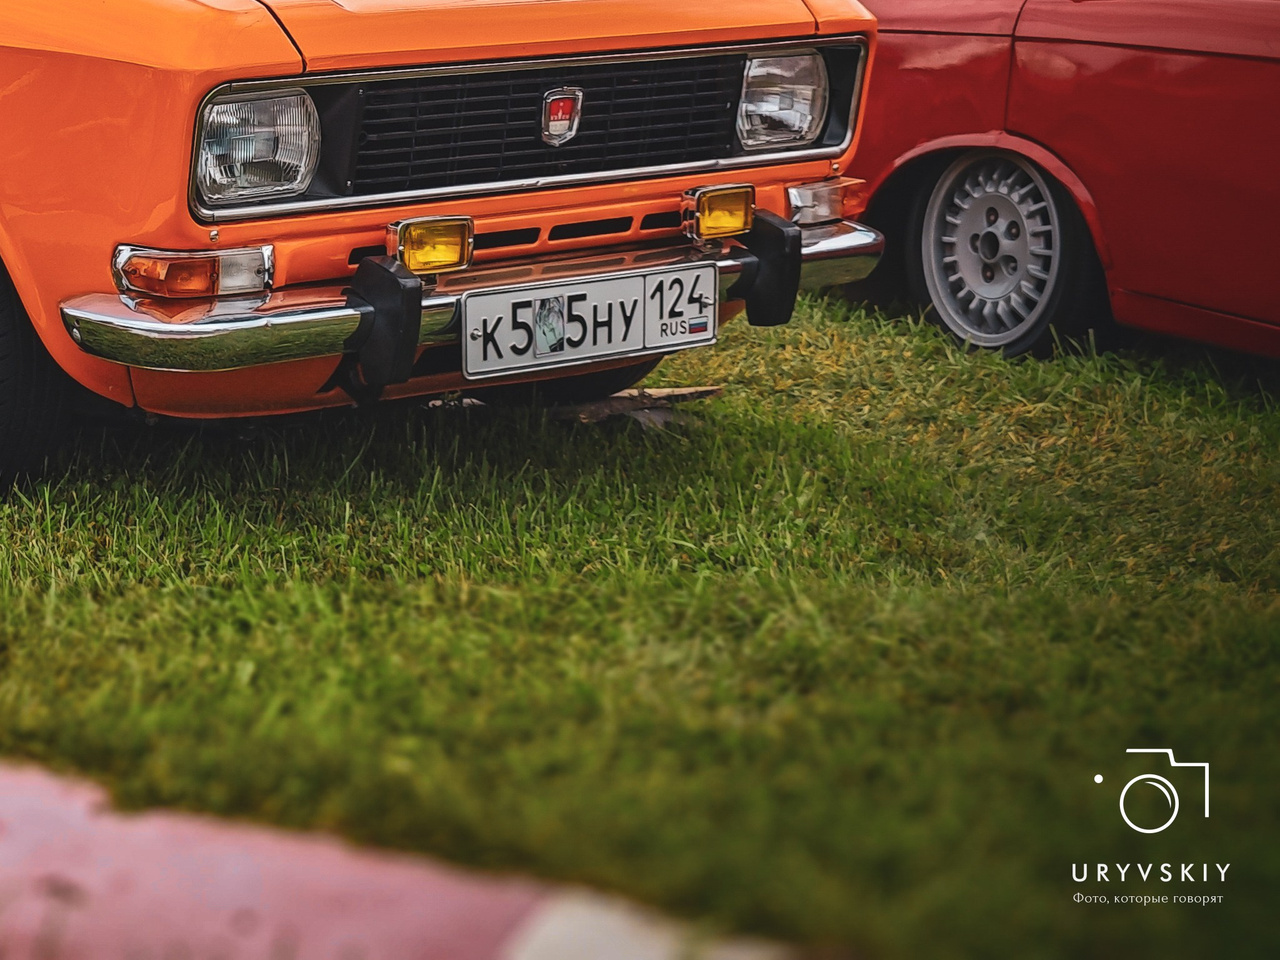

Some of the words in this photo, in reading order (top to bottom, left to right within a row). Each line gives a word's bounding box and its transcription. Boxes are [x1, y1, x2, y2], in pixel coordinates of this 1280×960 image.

[482, 292, 639, 361] К55НУ
[649, 273, 704, 321] 124
[660, 319, 687, 338] RUS
